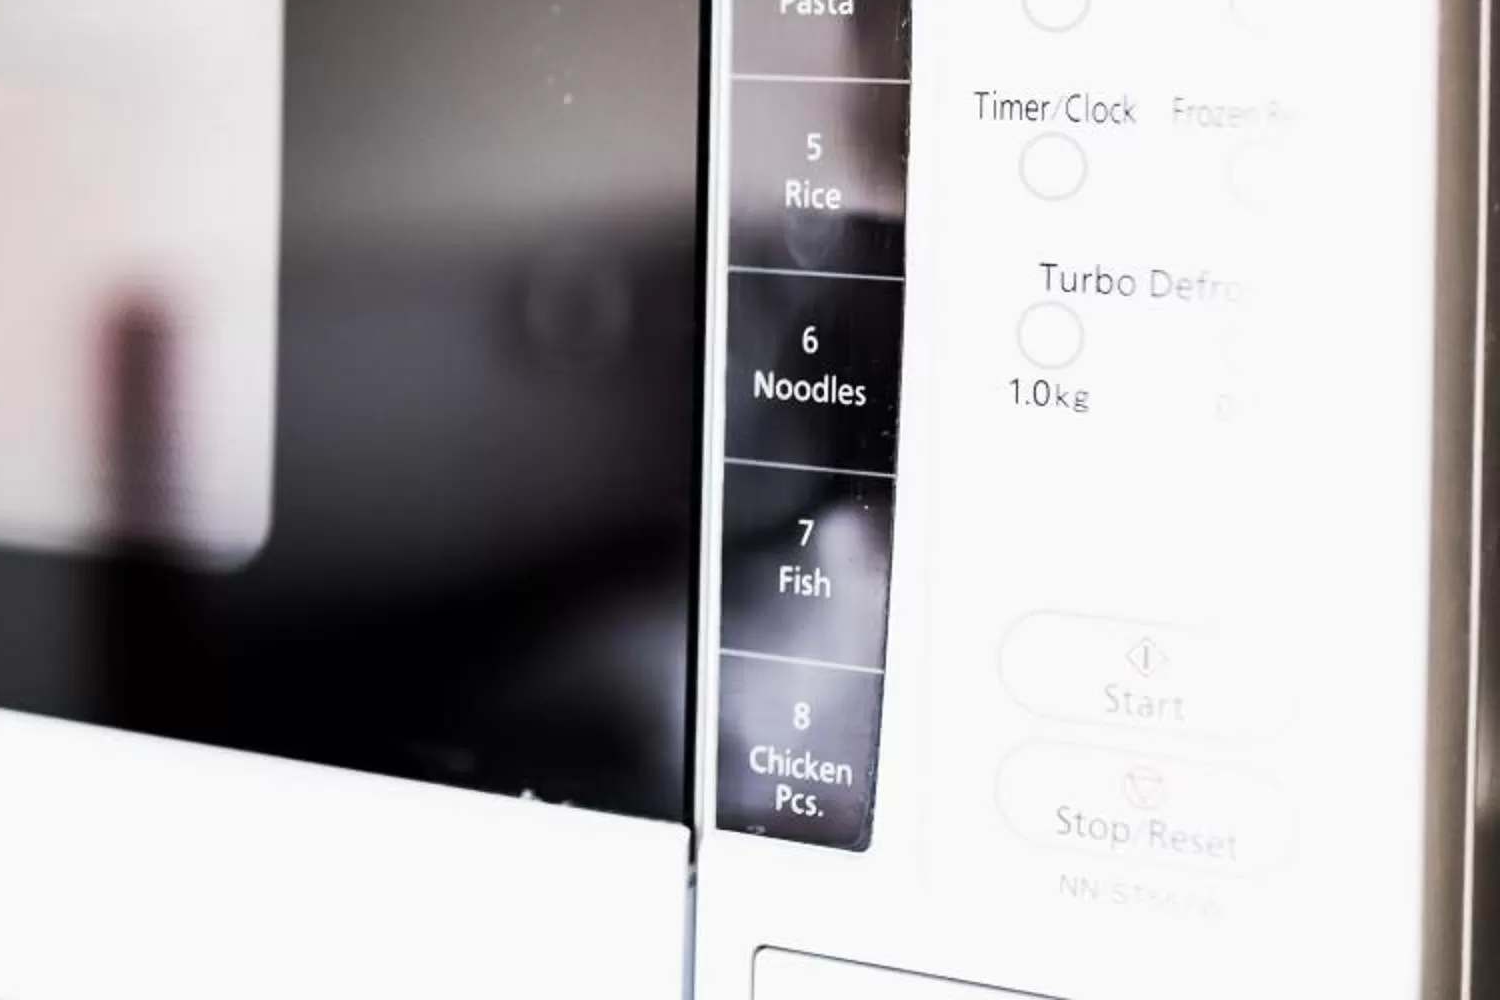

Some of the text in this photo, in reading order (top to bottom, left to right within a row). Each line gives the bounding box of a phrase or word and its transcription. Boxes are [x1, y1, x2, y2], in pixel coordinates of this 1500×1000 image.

[973, 90, 1138, 126] Timer/Clock
[1172, 94, 1259, 128] Frozen
[806, 132, 822, 161] 5
[784, 179, 842, 210] Rice
[1038, 261, 1137, 297] Turbo
[801, 325, 819, 354] 6
[753, 370, 867, 405] Noodles
[1007, 378, 1091, 414] 1.0kg
[799, 519, 814, 546] 7
[778, 565, 831, 598] Fish
[792, 702, 811, 731] 8
[1104, 683, 1185, 722] Start
[749, 744, 853, 786] Chicken
[774, 783, 824, 818] Pcs.
[1056, 805, 1237, 862] Stop/Reset
